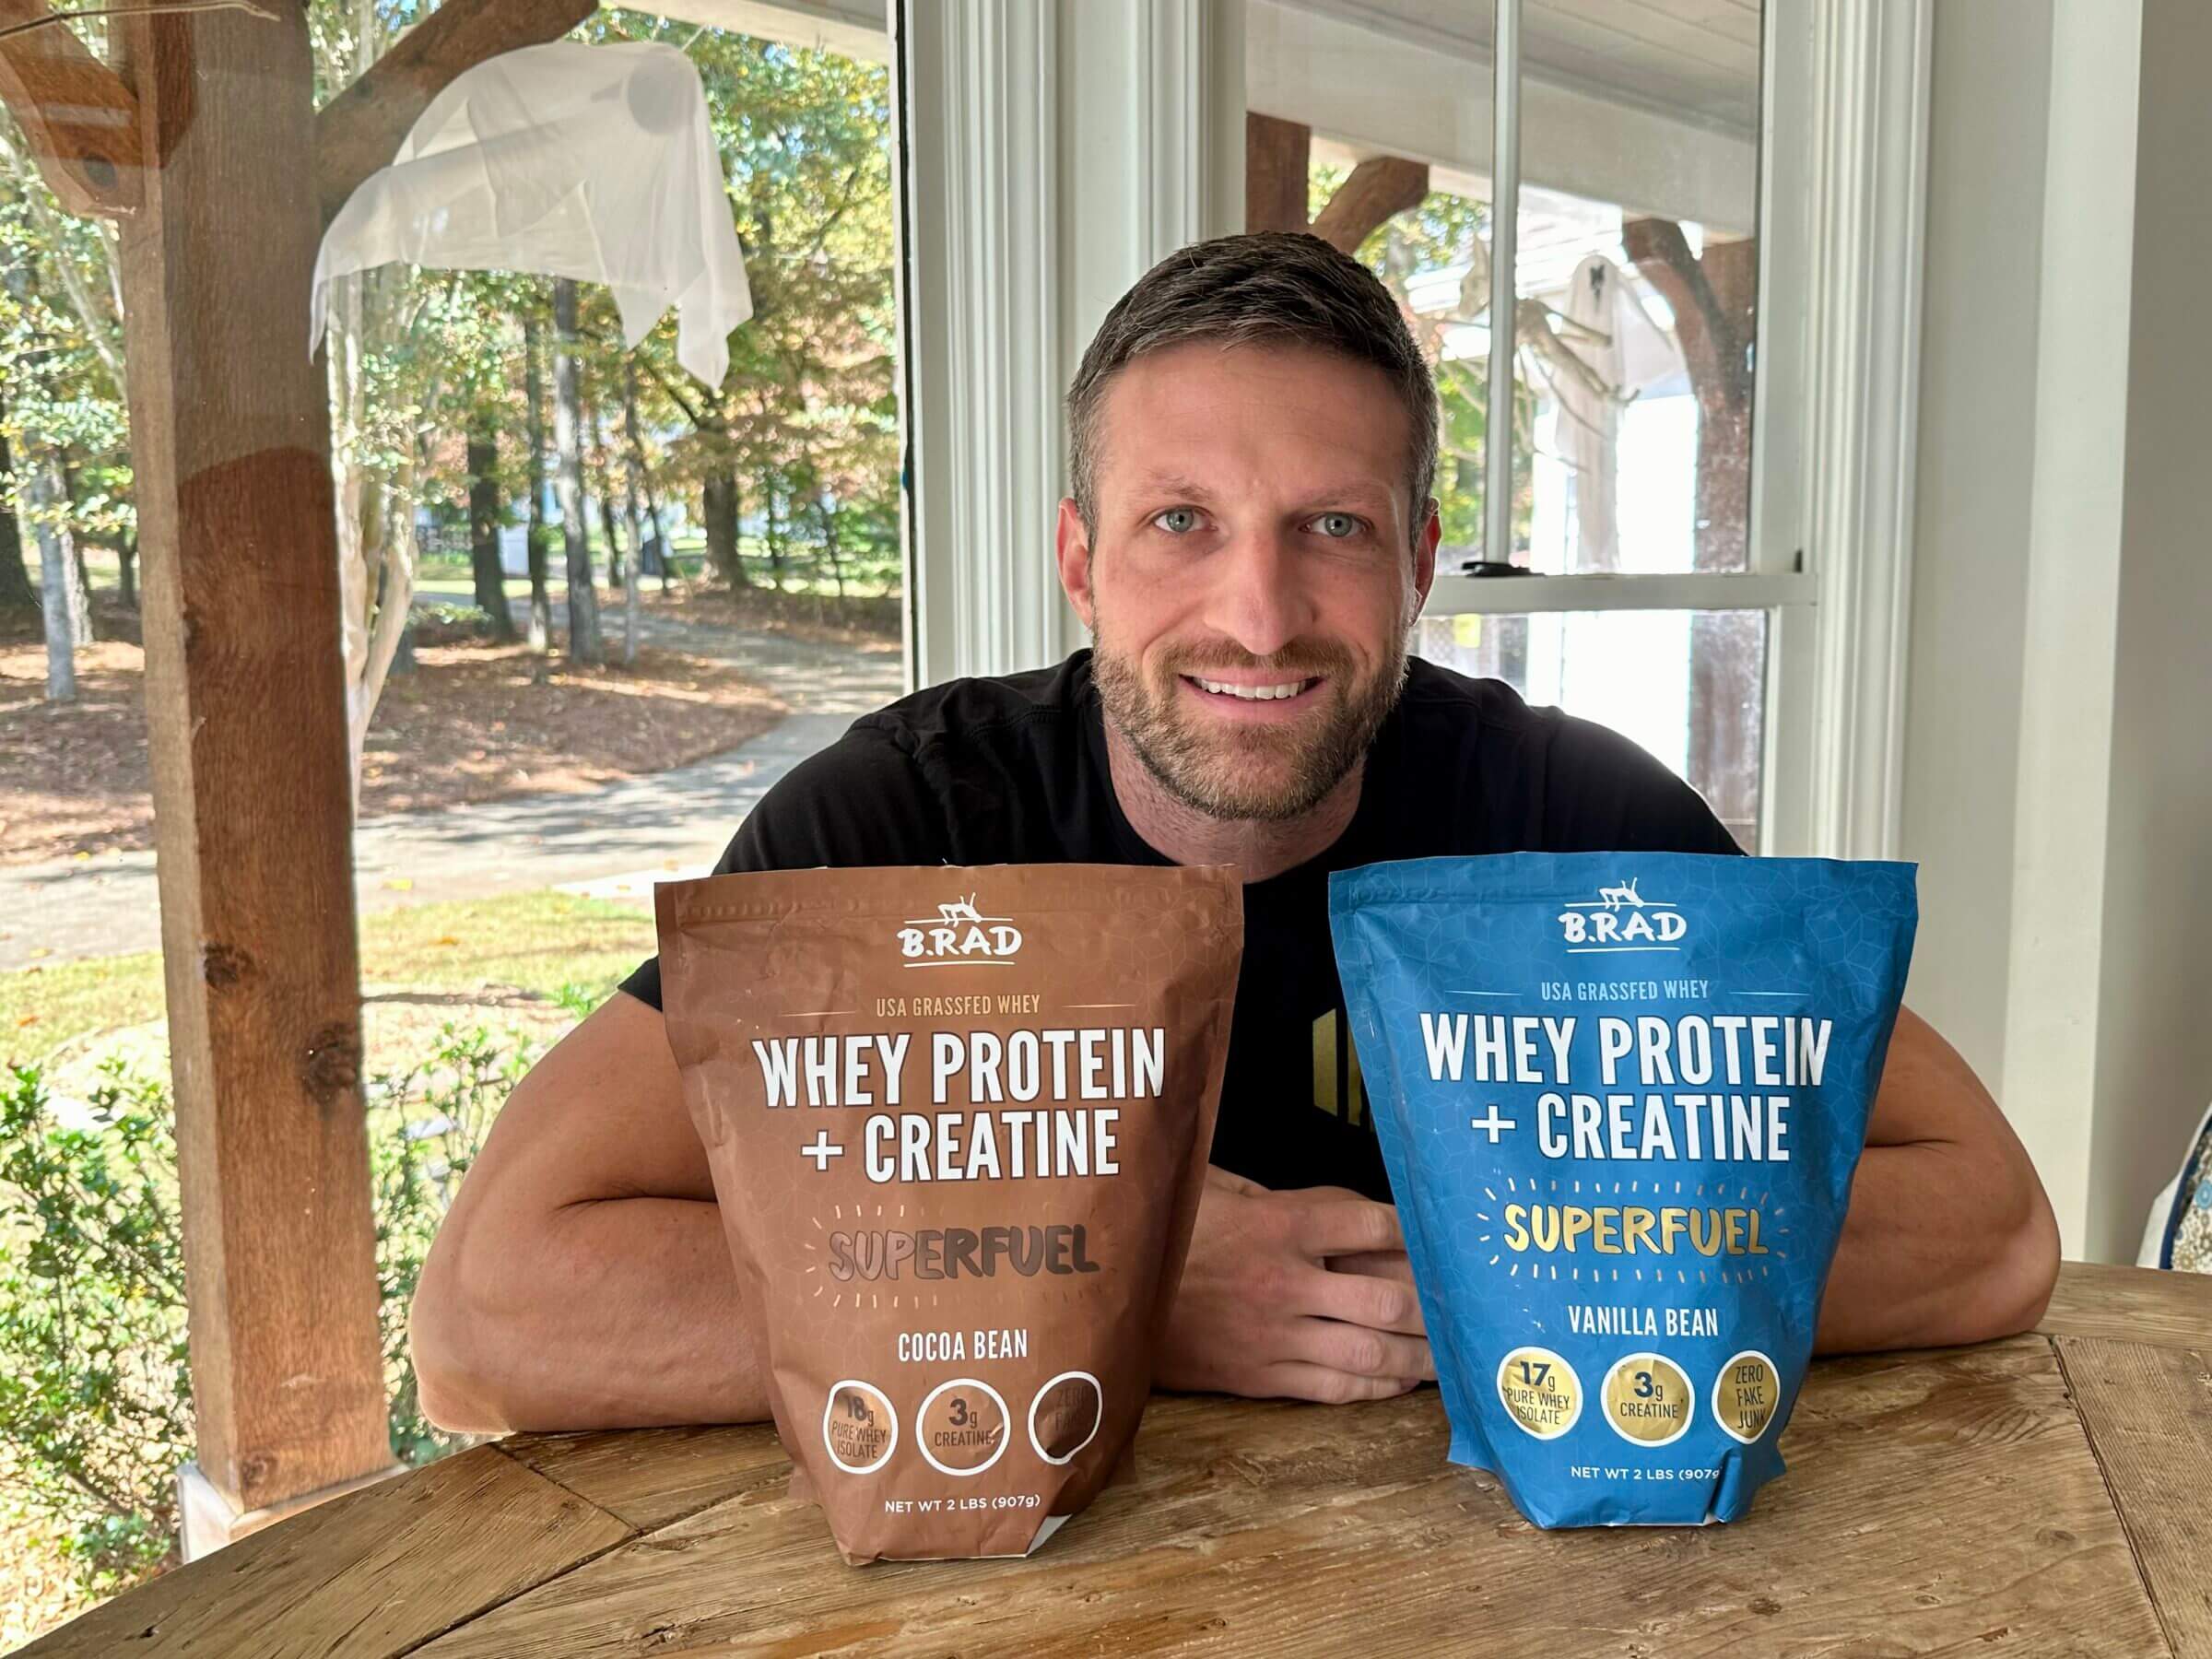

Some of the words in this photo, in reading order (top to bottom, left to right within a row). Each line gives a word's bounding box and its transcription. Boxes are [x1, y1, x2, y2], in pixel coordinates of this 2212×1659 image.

[1559, 911, 1688, 944] B.RAD
[897, 926, 1022, 957] B.RAD
[1541, 981, 1572, 1002] USA
[1577, 980, 1658, 1002] GRASSFED
[1664, 979, 1709, 1000] WHEY
[877, 998, 908, 1018] USA
[912, 996, 992, 1017] GRASSFED
[997, 994, 1041, 1014] WHEY
[1419, 1012, 1578, 1085] WHEY
[1598, 1014, 1832, 1088] PROTEIN
[752, 1033, 912, 1108] WHEY
[931, 1027, 1165, 1104] PROTEIN
[1471, 1105, 1516, 1144] +
[1536, 1092, 1791, 1162] CREATINE
[800, 1130, 844, 1171] +
[864, 1109, 1121, 1183] CREATINE
[1503, 1203, 1770, 1257] SUPERFUEL
[830, 1224, 1101, 1282] SUPERFUEL
[1568, 1306, 1658, 1336] VANILLA
[1666, 1308, 1719, 1337] BEAN
[899, 1331, 965, 1361] COCOA
[974, 1329, 1028, 1359] BEAN
[1520, 1360, 1555, 1392] 17g
[1634, 1371, 1664, 1402] 3g
[1735, 1364, 1763, 1384] ZERO
[1507, 1389, 1535, 1406] PURE
[1538, 1392, 1570, 1410] WHEY
[1737, 1386, 1764, 1407] FAKE
[948, 1398, 978, 1429] 3g
[1516, 1406, 1560, 1425] ISOLATE
[1620, 1403, 1679, 1419] CREATINE
[1737, 1410, 1765, 1430] JUNK
[832, 1420, 853, 1440] PURE
[855, 1428, 887, 1443] WHEY
[935, 1430, 992, 1447] CREATINE
[837, 1441, 877, 1459] ISOLATE
[1571, 1465, 1600, 1478] NET
[1605, 1467, 1628, 1479] WT
[1633, 1468, 1641, 1480] 2
[1647, 1468, 1675, 1480] LBS
[1678, 1468, 1721, 1482] (907g
[885, 1500, 913, 1513] NET
[918, 1500, 942, 1512] WT
[947, 1500, 955, 1511] 2
[959, 1497, 987, 1510] LBS
[992, 1494, 1041, 1510] (907g)
